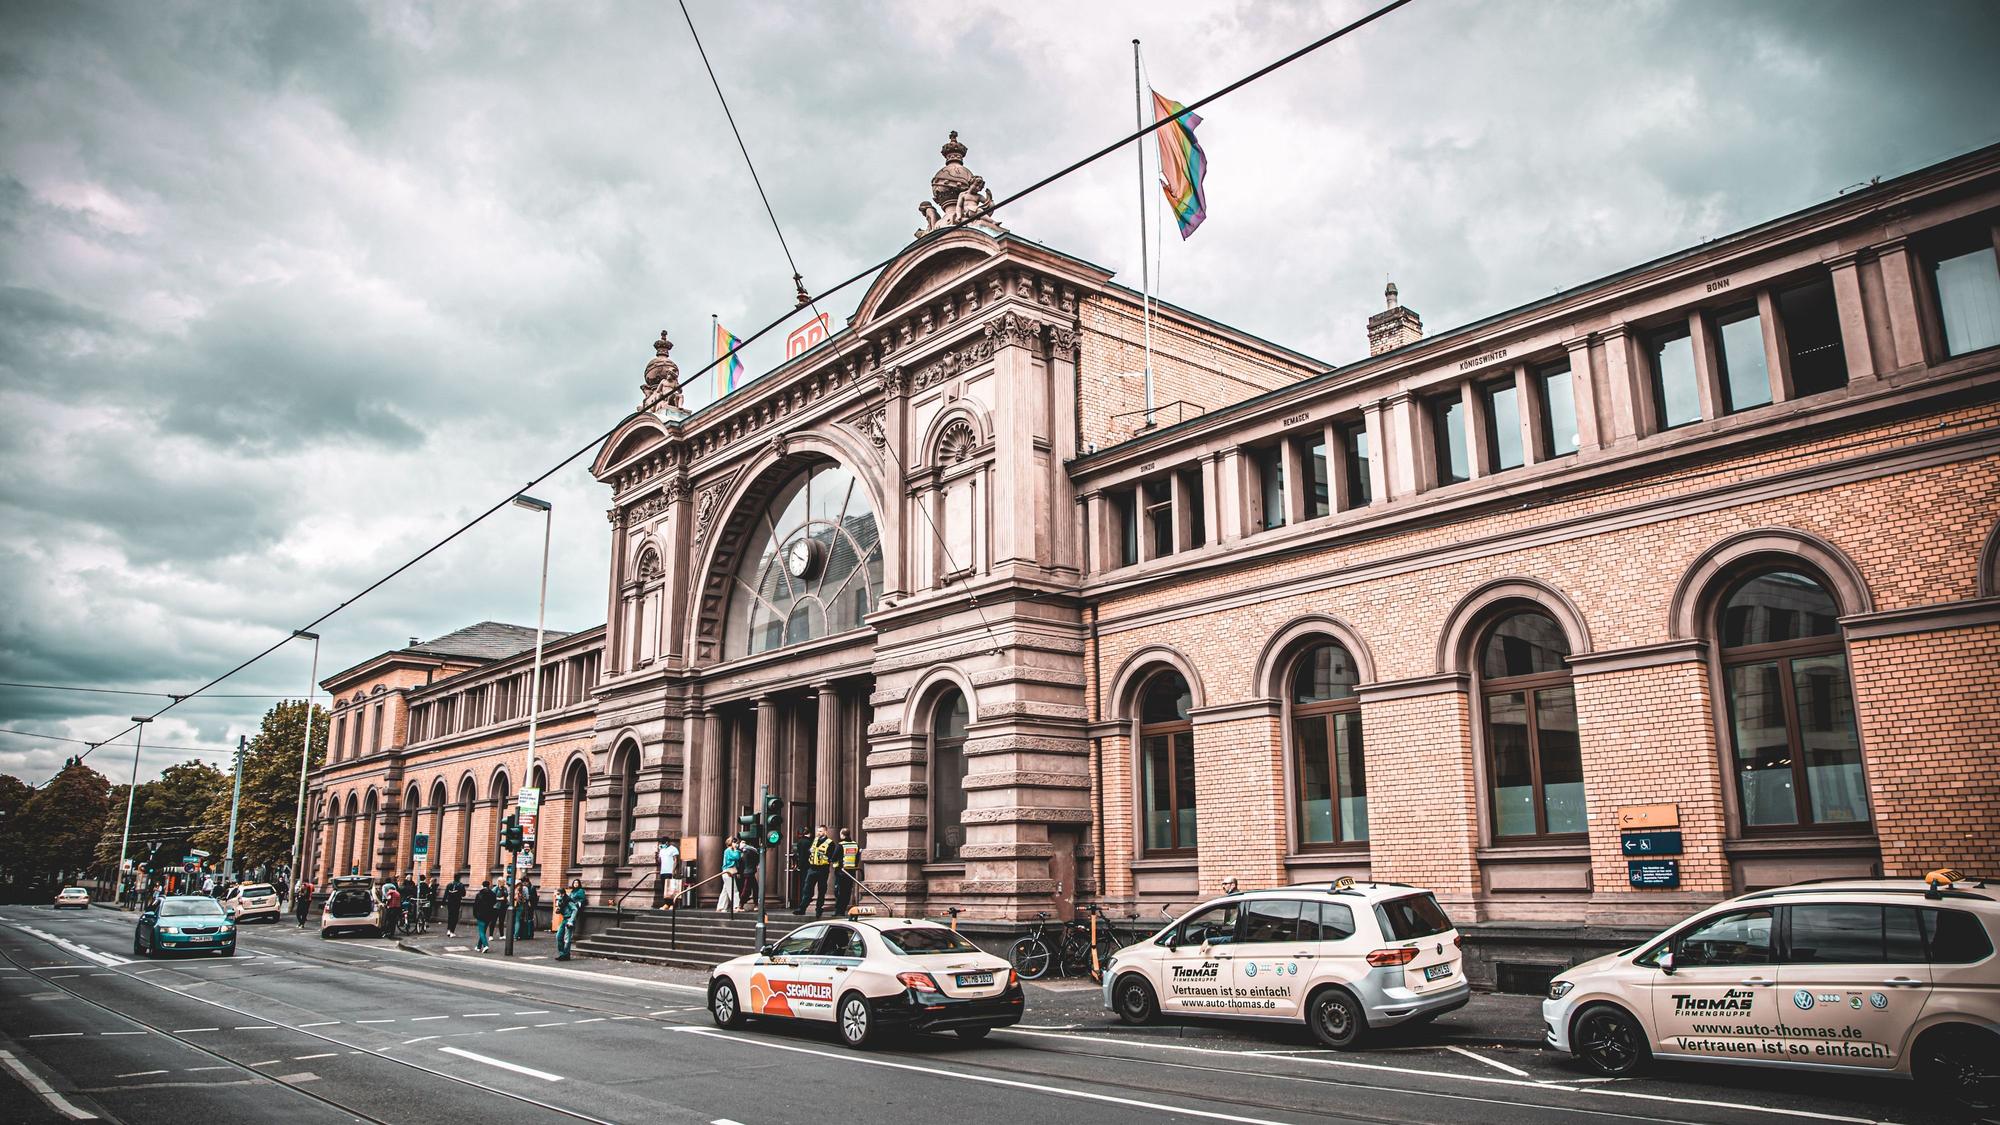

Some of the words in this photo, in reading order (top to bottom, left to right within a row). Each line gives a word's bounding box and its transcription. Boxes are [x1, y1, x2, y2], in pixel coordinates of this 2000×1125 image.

[1706, 278, 1730, 293] BONN
[1459, 349, 1508, 371] KÖNIGSWINTER
[1283, 412, 1310, 427] REMAGEN
[1172, 966, 1218, 977] THOMAS
[786, 983, 832, 1000] SEGMÜLLER
[1172, 985, 1218, 996] Vertrauen
[1220, 985, 1233, 996] ist
[1236, 987, 1247, 997] so
[1250, 986, 1291, 997] einfach!
[1181, 999, 1276, 1009] www.auto-thomas.de
[1671, 994, 1753, 1010] THOMAS
[1675, 1009, 1752, 1017] FIRMENGRUPPE
[1692, 1023, 1863, 1039] www.auto-thomas.de
[1676, 1037, 1757, 1053] Vertrauen
[1762, 1039, 1785, 1055] ist
[1789, 1043, 1810, 1056] so
[1815, 1041, 1891, 1058] einfach!
